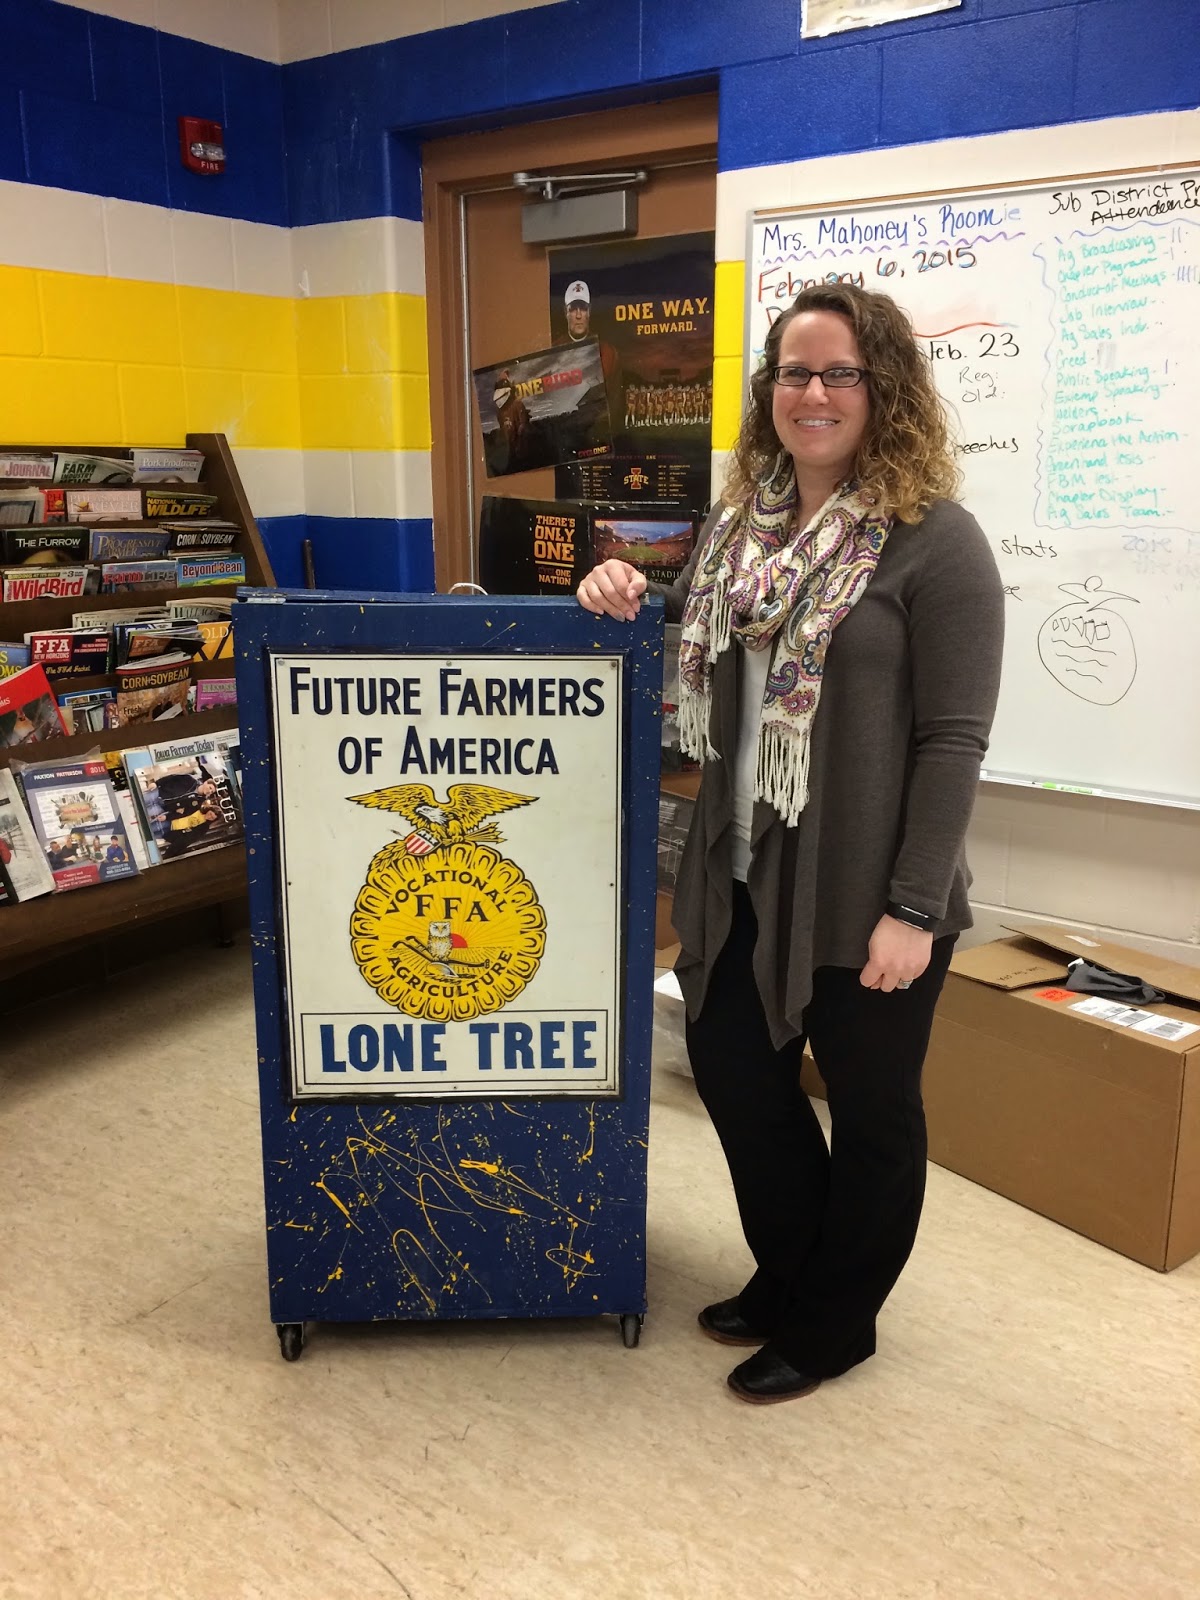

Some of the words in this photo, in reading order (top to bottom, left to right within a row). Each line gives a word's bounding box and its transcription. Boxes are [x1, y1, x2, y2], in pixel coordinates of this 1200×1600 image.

[200, 160, 219, 171] FIRE
[1048, 191, 1082, 216] Sub
[1090, 181, 1174, 207] District
[762, 223, 808, 256] Mrs.
[817, 213, 928, 246] Mahoney's
[911, 243, 978, 274] 2015
[615, 302, 654, 322] ONE
[661, 297, 711, 317] WAY.
[1059, 303, 1083, 324] Job
[636, 320, 697, 336] FORWARD.
[929, 339, 968, 361] Feb.
[978, 332, 1020, 358] 23
[1055, 348, 1087, 371] Creed
[1093, 365, 1151, 384] Speaking
[1103, 382, 1161, 401] Speaking
[5, 461, 51, 477] JOURNAL
[61, 462, 97, 474] FARM
[142, 457, 162, 467] Pork
[163, 458, 199, 467] Producer
[60, 472, 95, 480] INDUSTRY
[623, 473, 649, 486] STATE
[70, 501, 140, 513] FREVER
[147, 497, 177, 505] NATIONAL
[146, 503, 211, 517] WILDLIFE
[535, 514, 576, 528] THERE'S
[176, 533, 196, 547] CORN
[200, 533, 235, 545] SOYBEAN
[534, 524, 576, 543] ONLY
[15, 538, 37, 548] THE
[38, 537, 82, 547] FURROW
[533, 540, 575, 562] ONE
[67, 570, 75, 578] 3
[182, 562, 217, 578] Beyond
[651, 569, 681, 579] STADIU
[538, 573, 572, 586] NATION
[12, 577, 84, 601] WildBird
[201, 626, 229, 640] OLD
[34, 638, 71, 654] FFA
[34, 652, 46, 660] NEW
[46, 652, 70, 660] HORIZONS
[289, 666, 422, 716] FUTURE
[439, 667, 606, 718] FARMERS
[153, 748, 171, 760] Iowa
[169, 743, 195, 757] Farmer
[193, 739, 215, 754] Today
[337, 736, 383, 776] OF
[399, 725, 561, 776] AMERICA
[33, 772, 55, 780] PAXTON
[212, 774, 237, 823] BLUE
[385, 868, 508, 916] VOCATIONAL
[414, 893, 491, 923] FFA
[386, 950, 514, 999] AGRICULTURE
[319, 1023, 448, 1073] LONE
[468, 1020, 598, 1071] TREE
